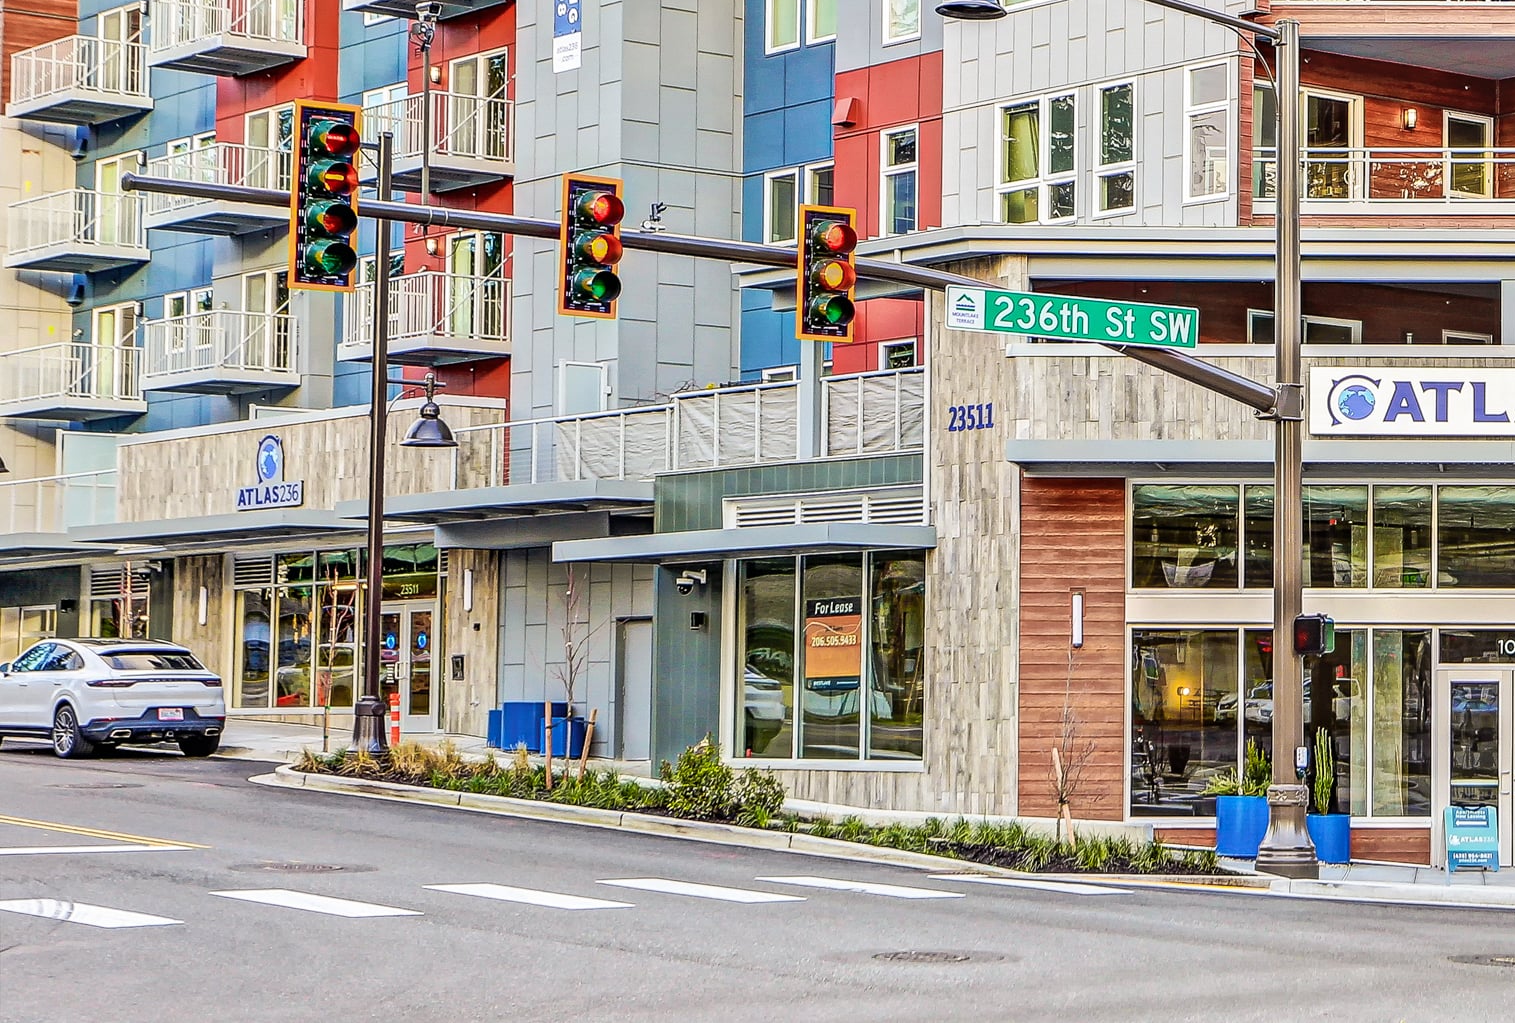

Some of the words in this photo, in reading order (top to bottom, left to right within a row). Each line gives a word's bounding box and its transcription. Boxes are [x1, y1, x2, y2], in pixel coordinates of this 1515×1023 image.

[951, 311, 979, 320] MOUNTLAKE
[993, 296, 1090, 335] 236th
[1105, 306, 1135, 339] St
[1149, 311, 1192, 344] SW
[948, 402, 995, 432] 23511
[237, 483, 299, 507] ATLAS236
[400, 583, 420, 595] 23511
[814, 602, 829, 615] For
[830, 601, 854, 613] Lease
